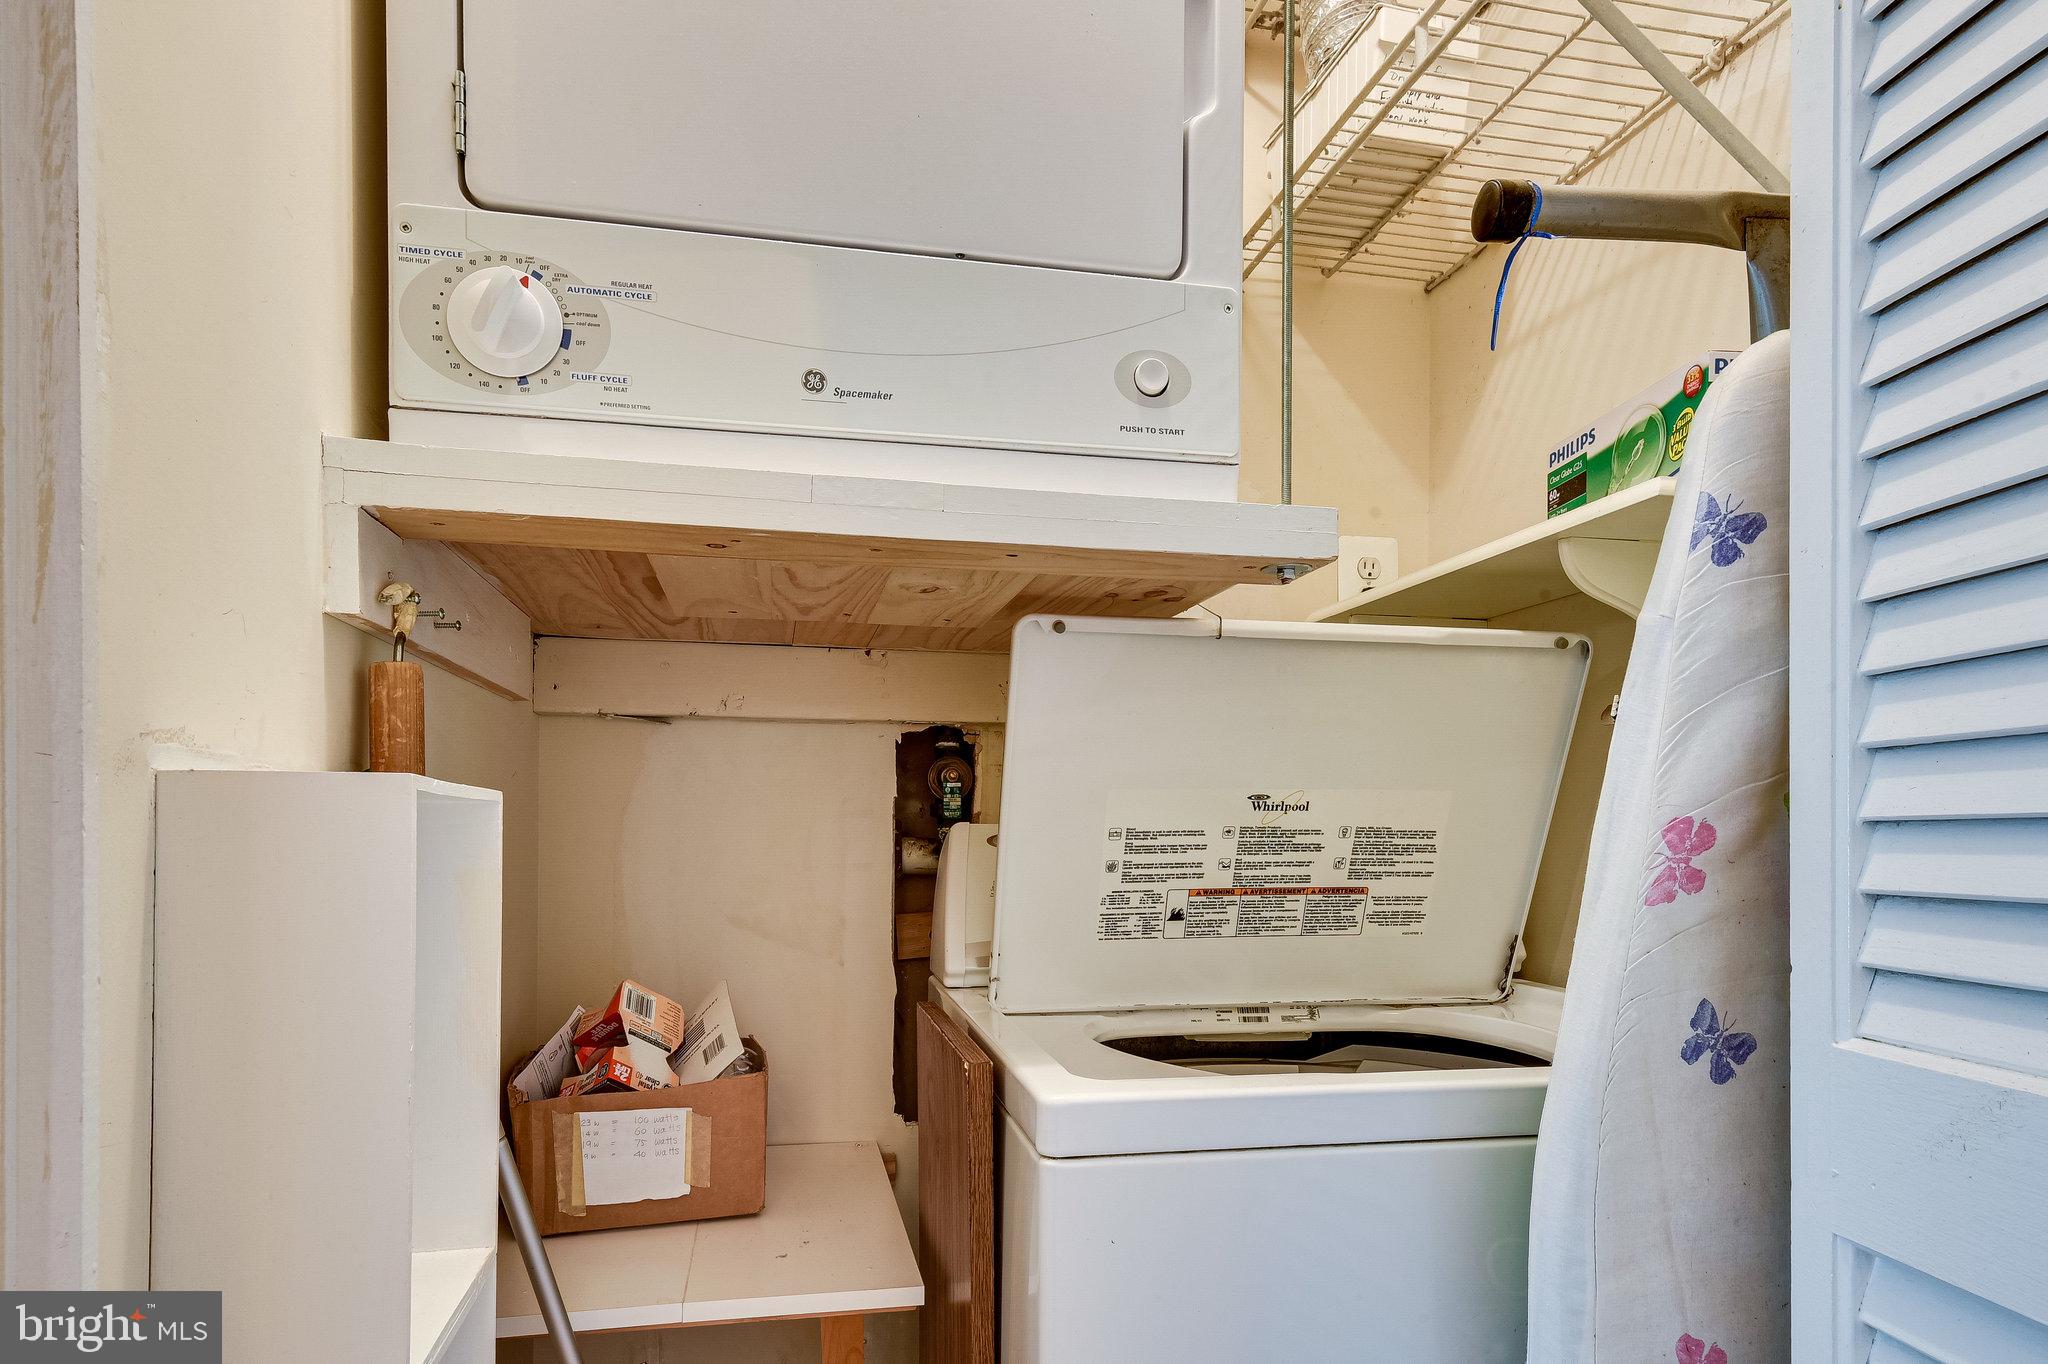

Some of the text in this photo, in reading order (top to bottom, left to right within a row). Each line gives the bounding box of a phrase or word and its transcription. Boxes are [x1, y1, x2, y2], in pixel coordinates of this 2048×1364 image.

[399, 246, 463, 258] TIMED CYCLE
[611, 281, 637, 289] REGULAR
[567, 286, 652, 300] AUTOMATIC CYCLE
[432, 334, 443, 342] 100
[450, 362, 461, 370] 120
[571, 373, 628, 384] FLUFF CYCLE
[479, 380, 490, 388] 140
[833, 387, 893, 400] Spacemaker
[1120, 425, 1143, 433] PUSH
[1158, 428, 1185, 436] START
[1549, 427, 1596, 468] PHILIPS
[1251, 800, 1310, 815] Whirlpool
[1203, 888, 1235, 896] WARNING
[634, 1116, 649, 1124] 100
[653, 1114, 679, 1124] watts
[634, 1127, 647, 1136] 60
[634, 1139, 647, 1147] 75
[654, 1137, 678, 1146] watts
[633, 1150, 647, 1158] 40
[655, 1147, 680, 1157] watts
